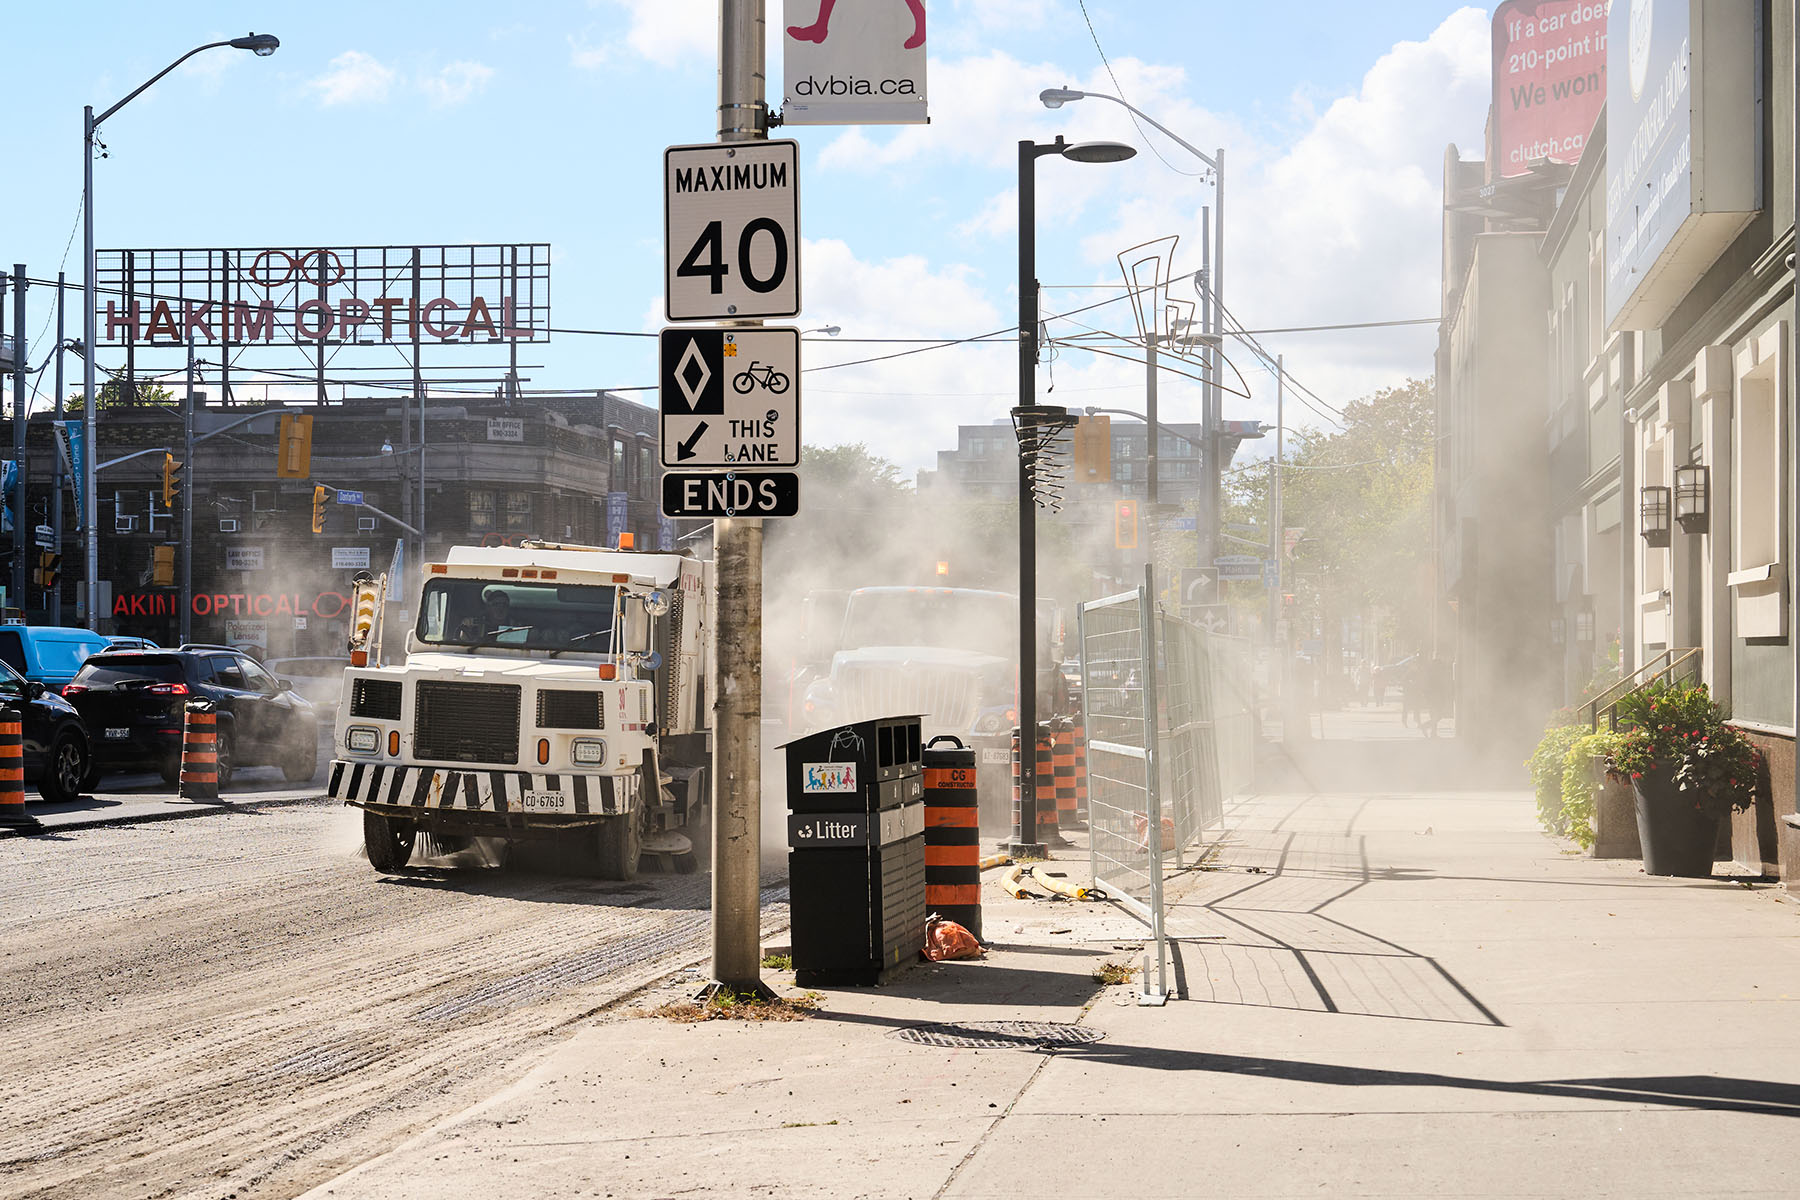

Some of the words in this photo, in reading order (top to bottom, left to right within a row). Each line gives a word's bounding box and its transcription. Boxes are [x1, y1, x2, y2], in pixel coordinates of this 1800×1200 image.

[1509, 20, 1521, 42] If
[1525, 23, 1535, 38] a
[1539, 14, 1567, 33] car
[1509, 35, 1591, 74] 210-point
[795, 75, 917, 96] dvbia.ca
[1510, 82, 1546, 112] We
[1510, 134, 1583, 163] clutch.ca
[676, 162, 787, 193] MAXIMUM
[677, 217, 788, 294] 40
[107, 300, 274, 340] HAKIM
[295, 296, 535, 339] OPTICAL
[729, 419, 775, 438] THIS
[724, 443, 779, 462] LANE
[683, 478, 778, 511] ENDS
[242, 550, 261, 558] OFFICE
[192, 592, 309, 617] OPTICAL
[233, 632, 260, 641] Lenses
[951, 770, 966, 781] CG
[540, 796, 565, 808] 67619
[816, 821, 857, 839] Litter
